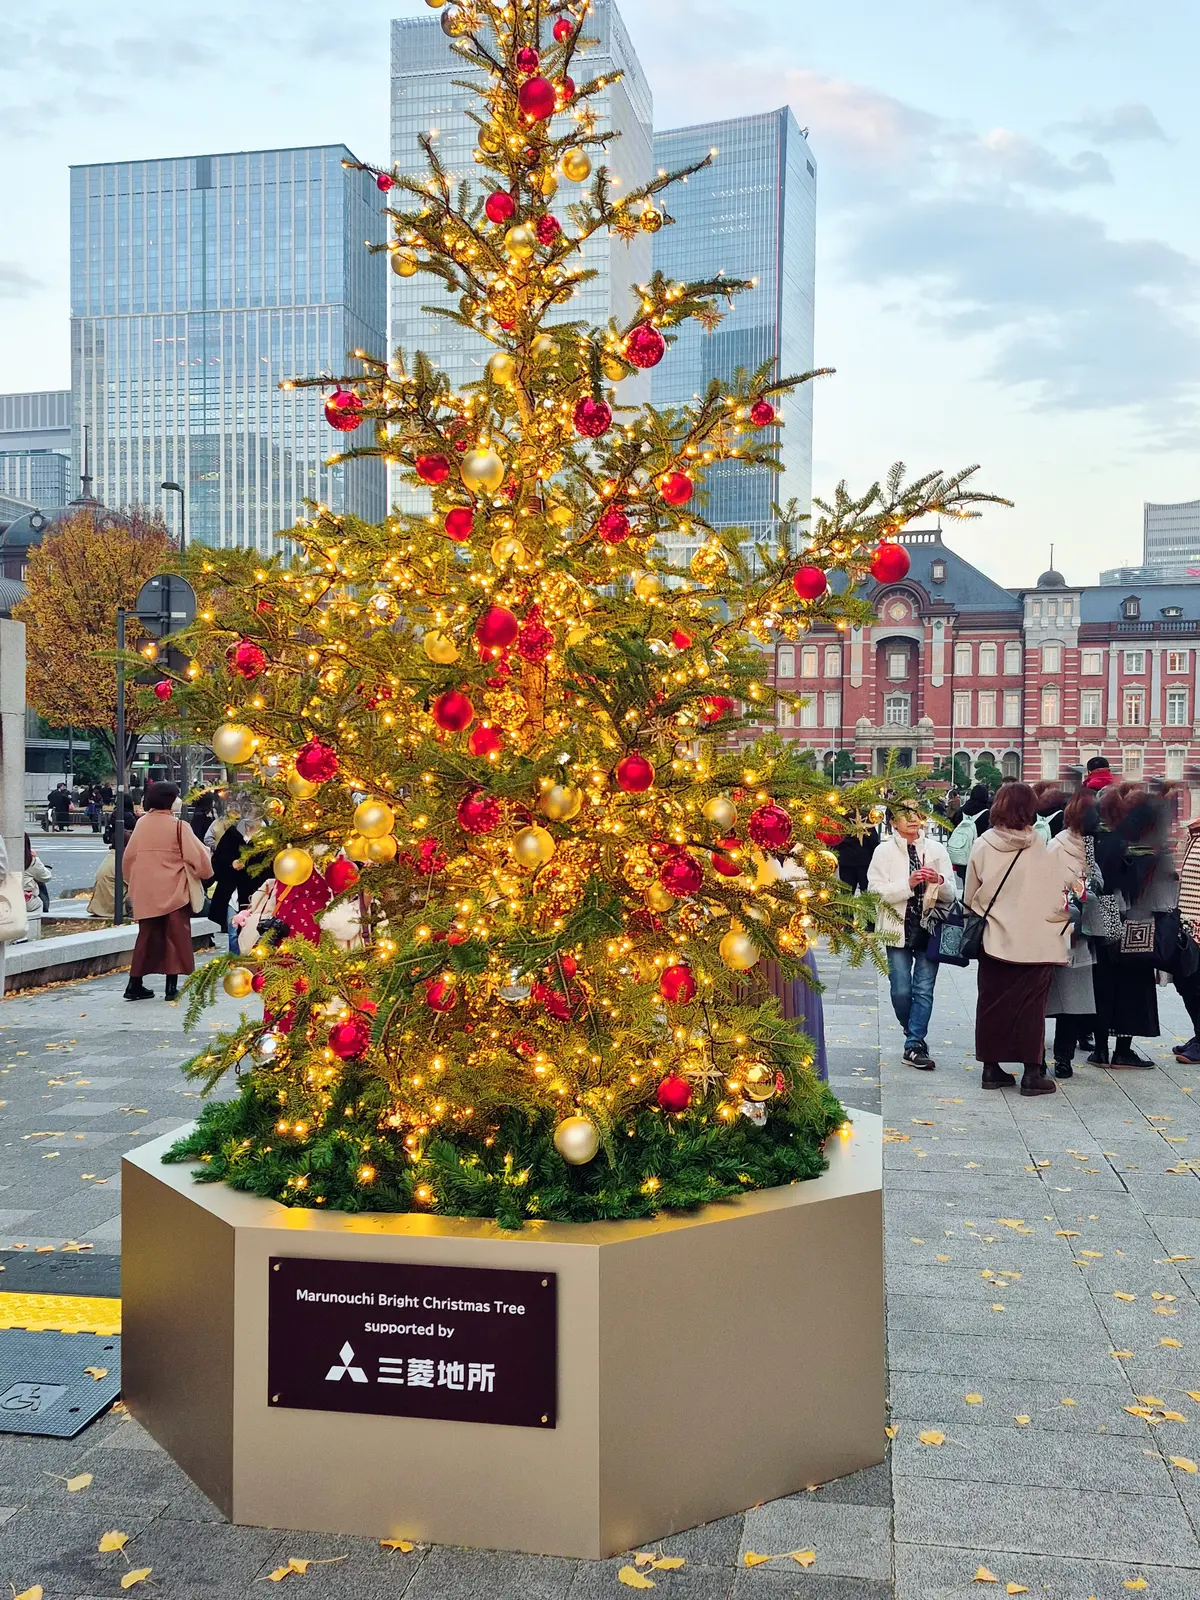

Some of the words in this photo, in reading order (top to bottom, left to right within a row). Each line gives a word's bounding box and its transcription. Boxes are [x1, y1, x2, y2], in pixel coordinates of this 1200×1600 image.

[296, 1288, 375, 1306] Marunouchi
[378, 1293, 420, 1309] Bright
[422, 1296, 491, 1313] Christmas
[493, 1300, 526, 1315] Tree
[364, 1321, 434, 1336] supported
[438, 1323, 455, 1339] by
[377, 1356, 496, 1393] 三菱地所
